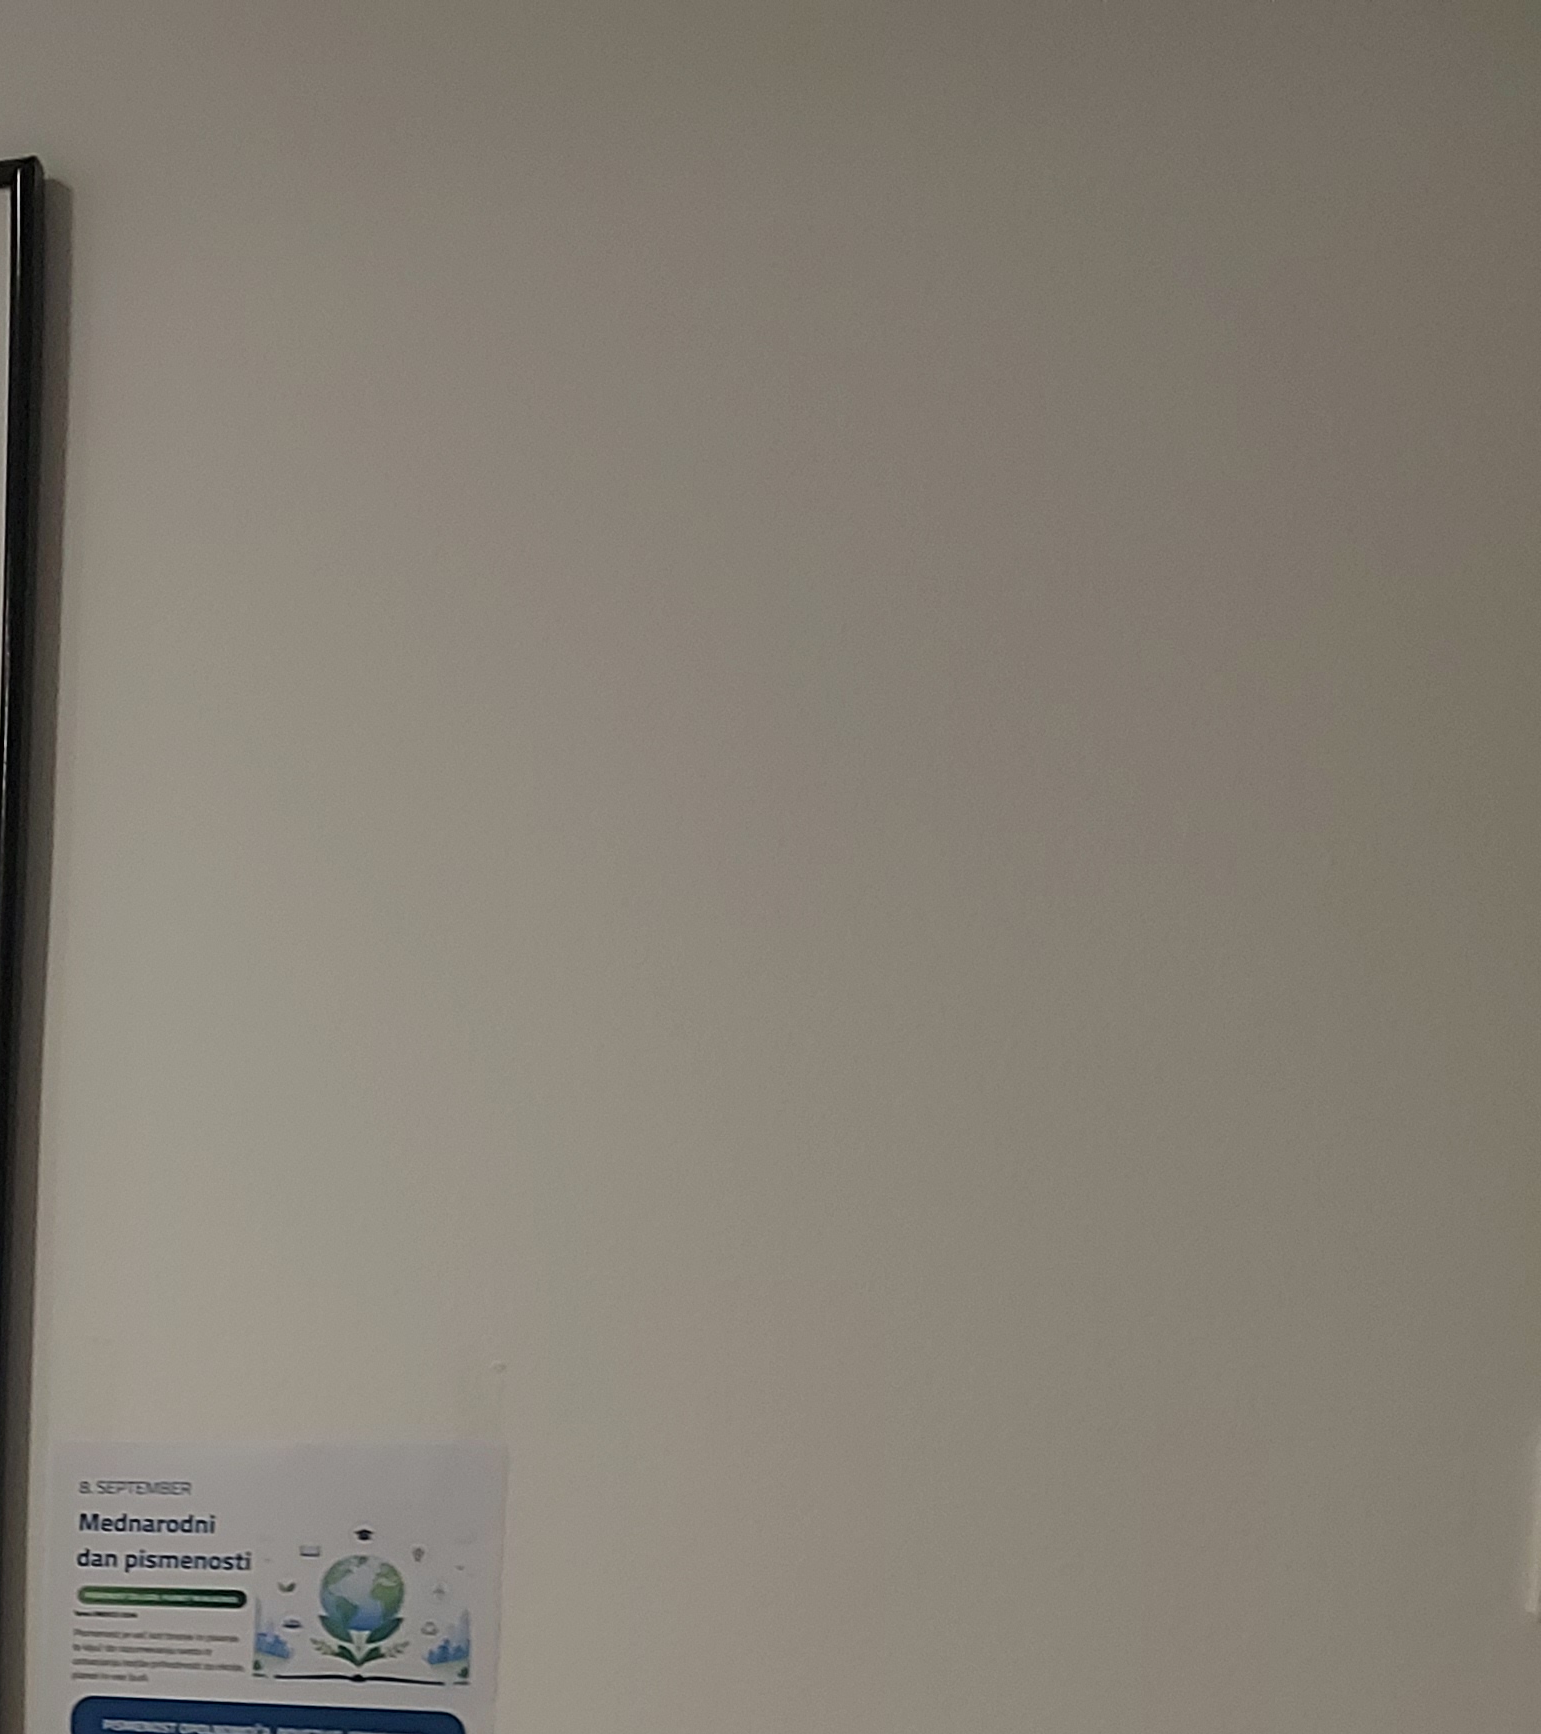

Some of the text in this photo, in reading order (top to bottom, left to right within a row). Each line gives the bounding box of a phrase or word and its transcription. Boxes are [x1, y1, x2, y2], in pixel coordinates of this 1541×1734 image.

[96, 1480, 192, 1496] SEPTEMBER
[78, 1513, 217, 1534] Mednarodni
[77, 1548, 253, 1573] dan pismenosti
